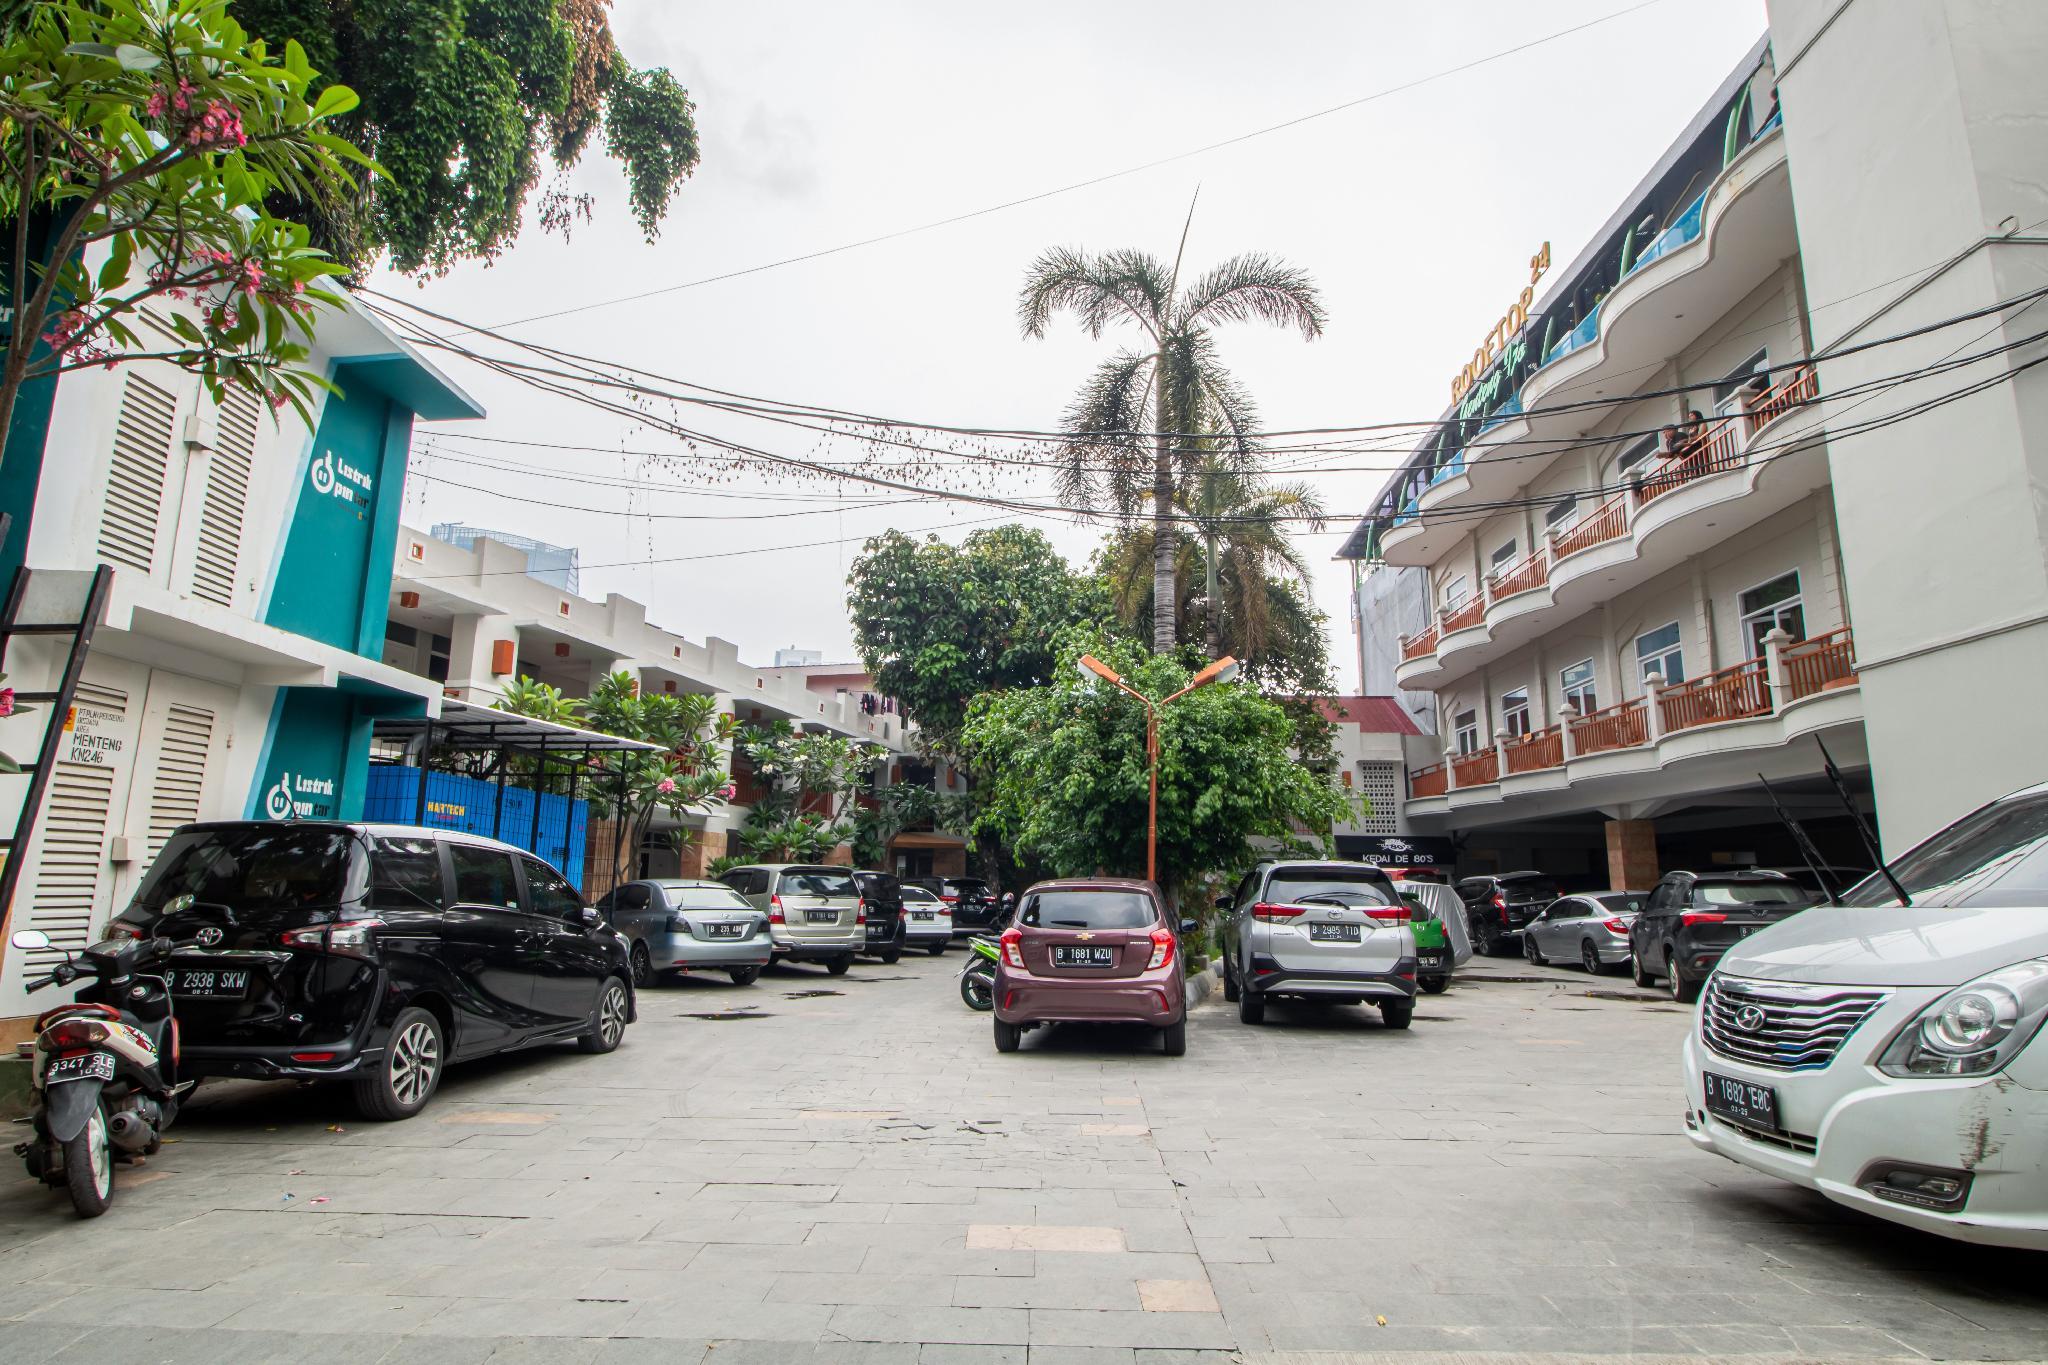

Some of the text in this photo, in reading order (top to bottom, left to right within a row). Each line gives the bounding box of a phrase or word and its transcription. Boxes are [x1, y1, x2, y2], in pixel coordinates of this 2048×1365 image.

[1451, 241, 1551, 407] ROOFTOP 24
[337, 457, 372, 490] Listrik
[73, 732, 122, 751] MENTENG
[296, 774, 333, 795] Listrik
[428, 801, 465, 816] HARTECH
[1362, 854, 1434, 863] KEDAI DE 80'S
[711, 925, 715, 933] B
[1312, 924, 1318, 934] B
[1322, 925, 1341, 935] 2995
[1057, 948, 1111, 960] B 1681 WZU
[165, 971, 247, 988] B 2938 SKW
[51, 1055, 114, 1072] 3347 SLE
[1707, 1075, 1714, 1095] B
[1721, 1078, 1745, 1105] 1882
